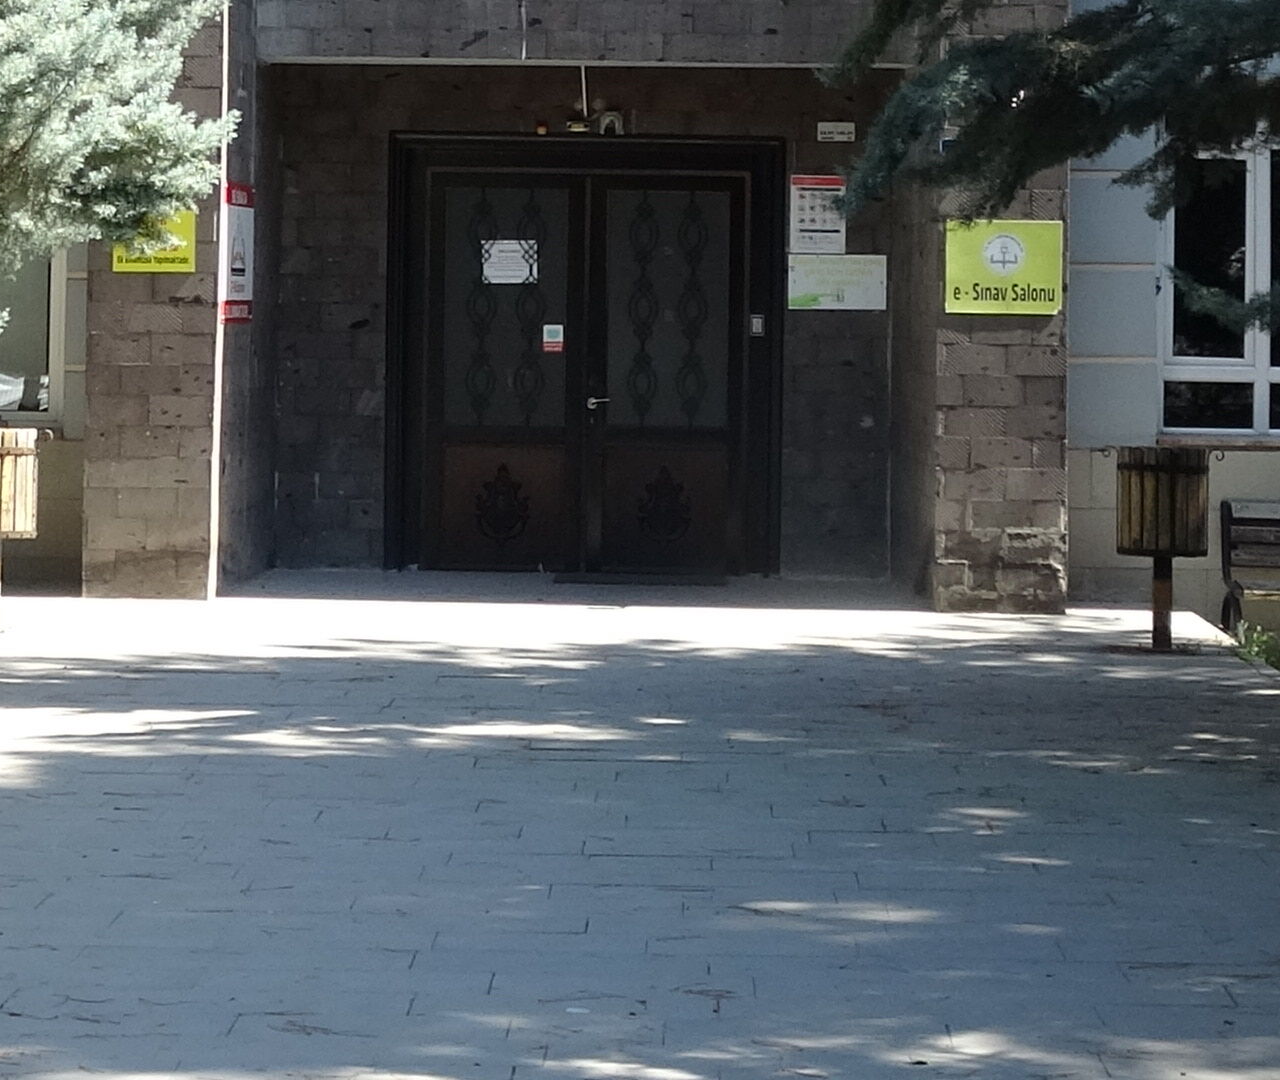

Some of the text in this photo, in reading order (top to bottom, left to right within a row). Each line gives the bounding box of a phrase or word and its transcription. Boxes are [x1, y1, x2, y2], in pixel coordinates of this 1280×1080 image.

[953, 286, 962, 301] e
[972, 283, 1008, 302] Sınav
[1011, 283, 1056, 302] Salonu
